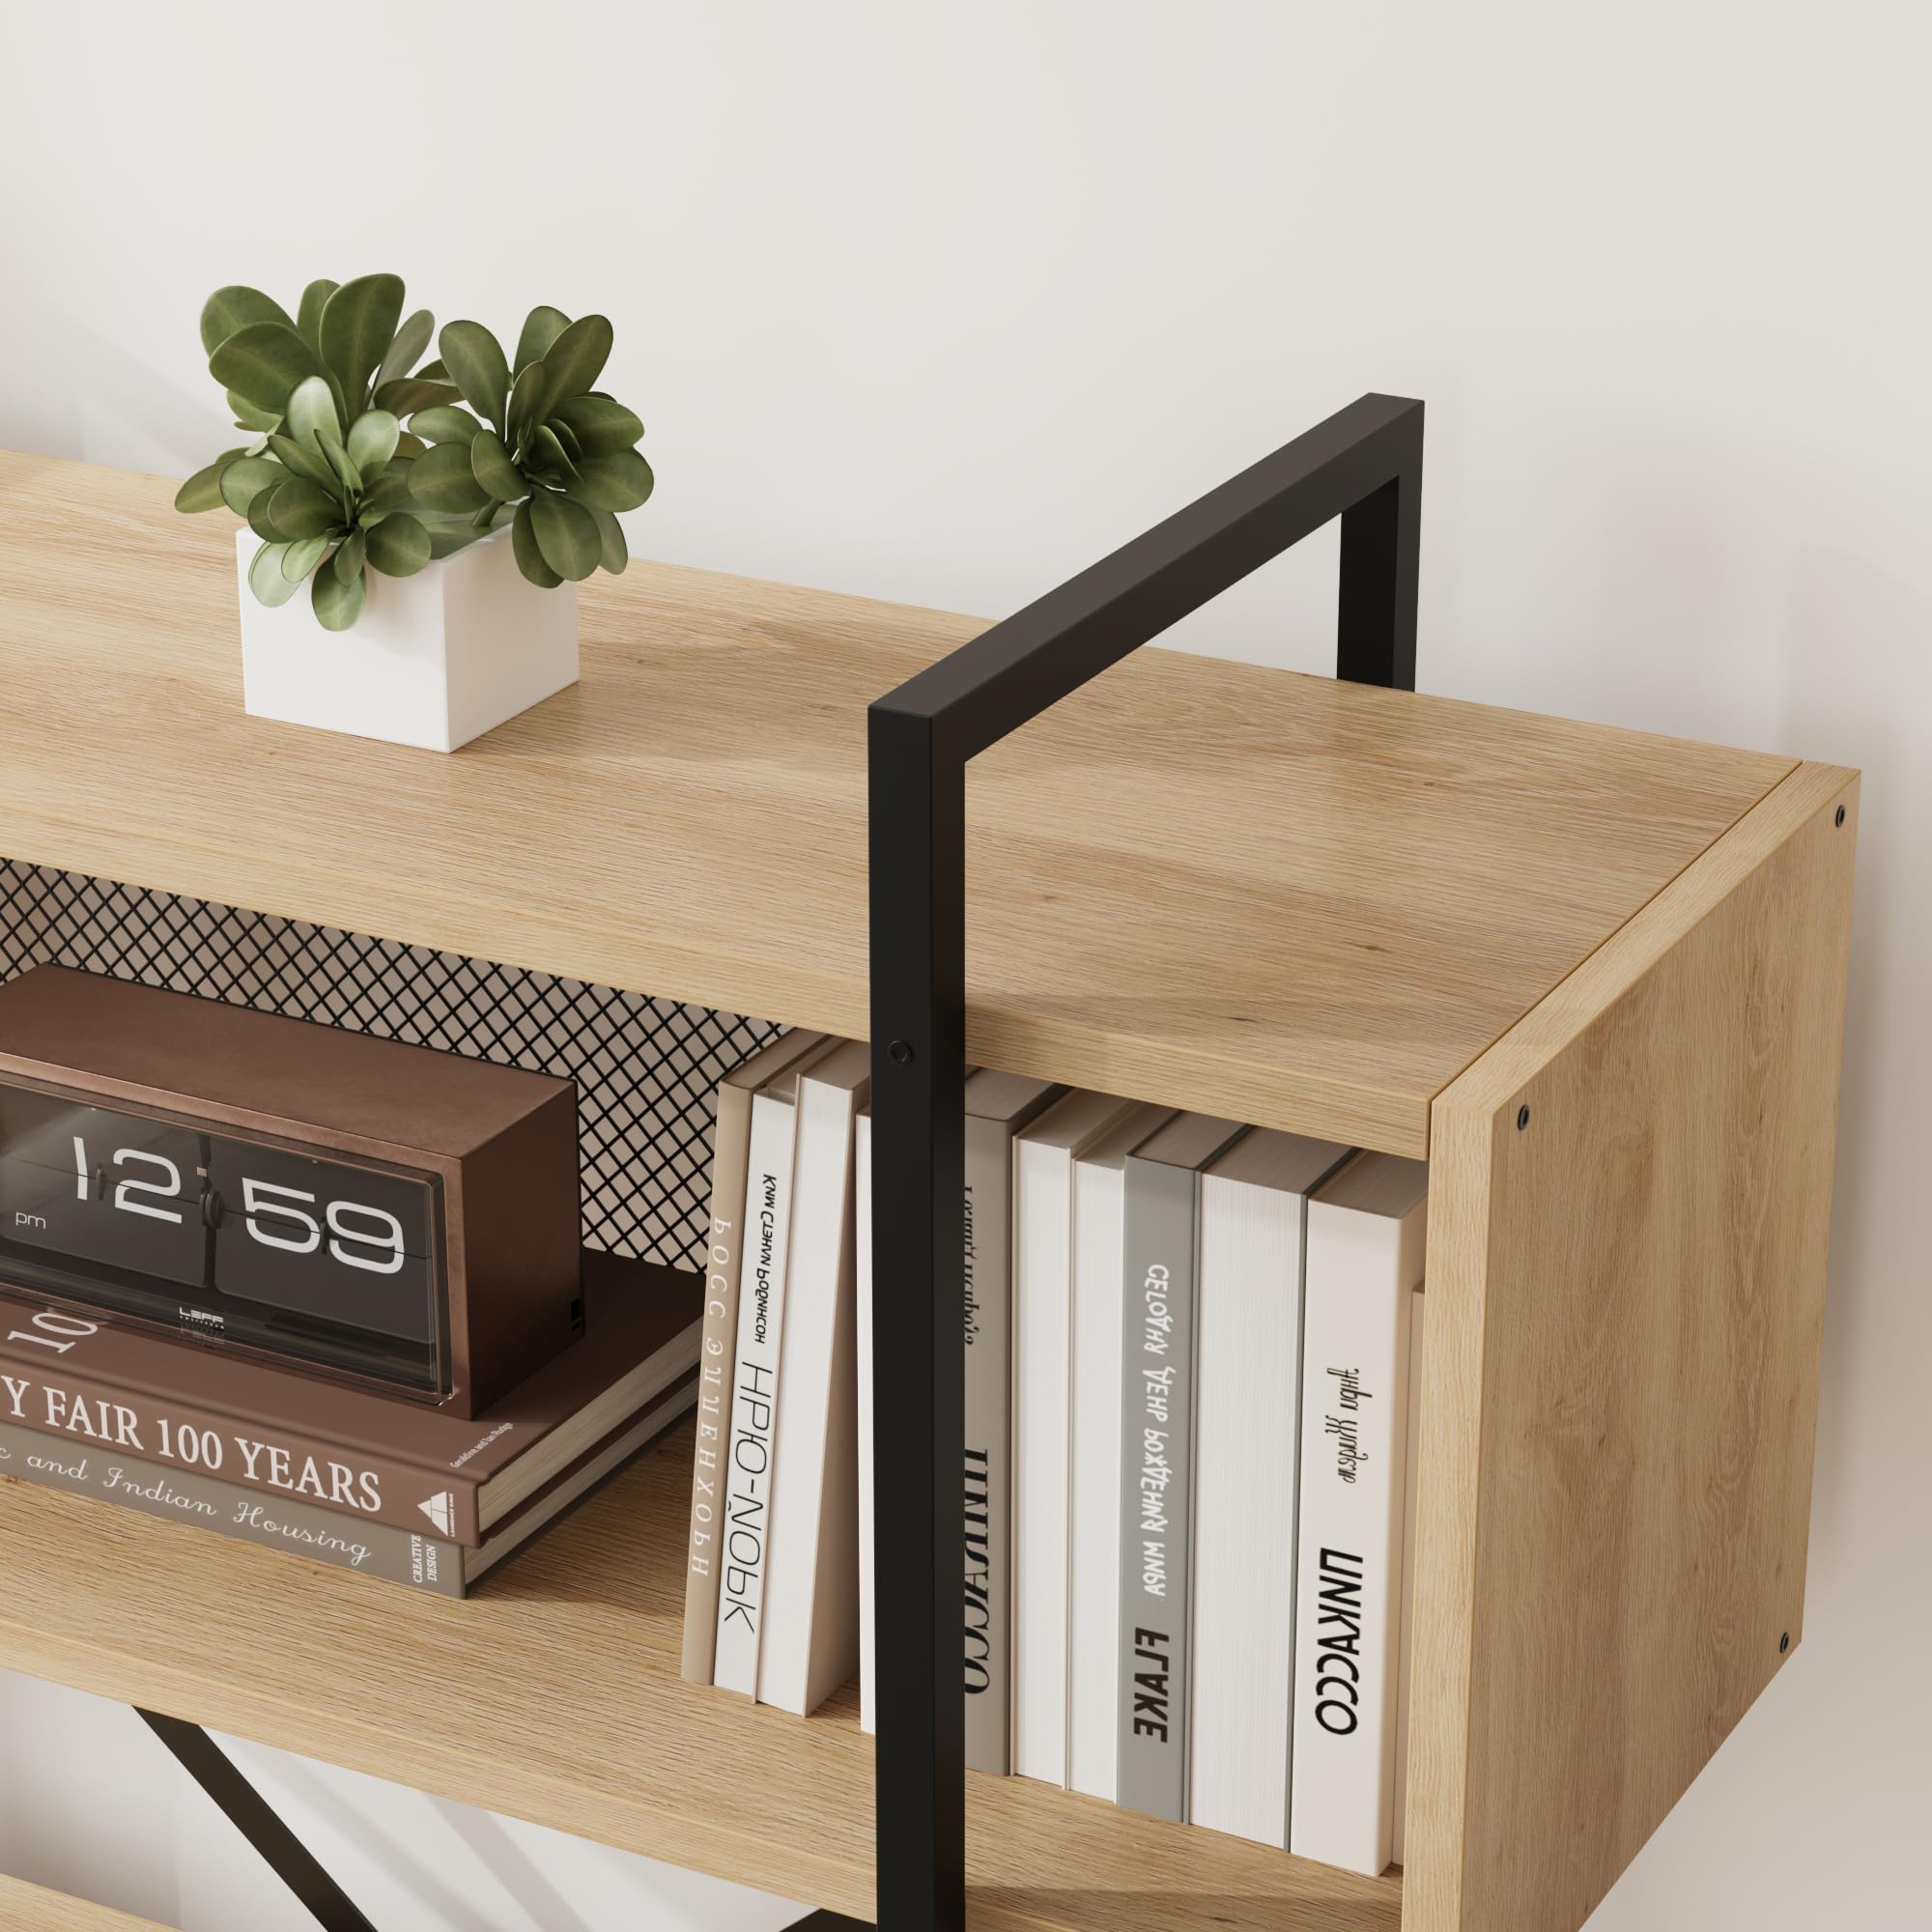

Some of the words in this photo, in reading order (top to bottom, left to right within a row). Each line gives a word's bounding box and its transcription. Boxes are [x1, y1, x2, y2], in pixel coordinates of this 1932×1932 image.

[14, 1210, 46, 1231] pm
[72, 1135, 183, 1225] 12
[242, 1177, 405, 1275] 59
[0, 1374, 31, 1418] Y
[43, 1385, 145, 1451] FAIR
[156, 1418, 224, 1471] 100
[233, 1435, 384, 1514] YEARS
[26, 1458, 90, 1481] and
[102, 1466, 218, 1517] Indian
[232, 1501, 373, 1568] Housing
[411, 1534, 424, 1584] CREATIVE
[425, 1544, 438, 1582] DESIGN
